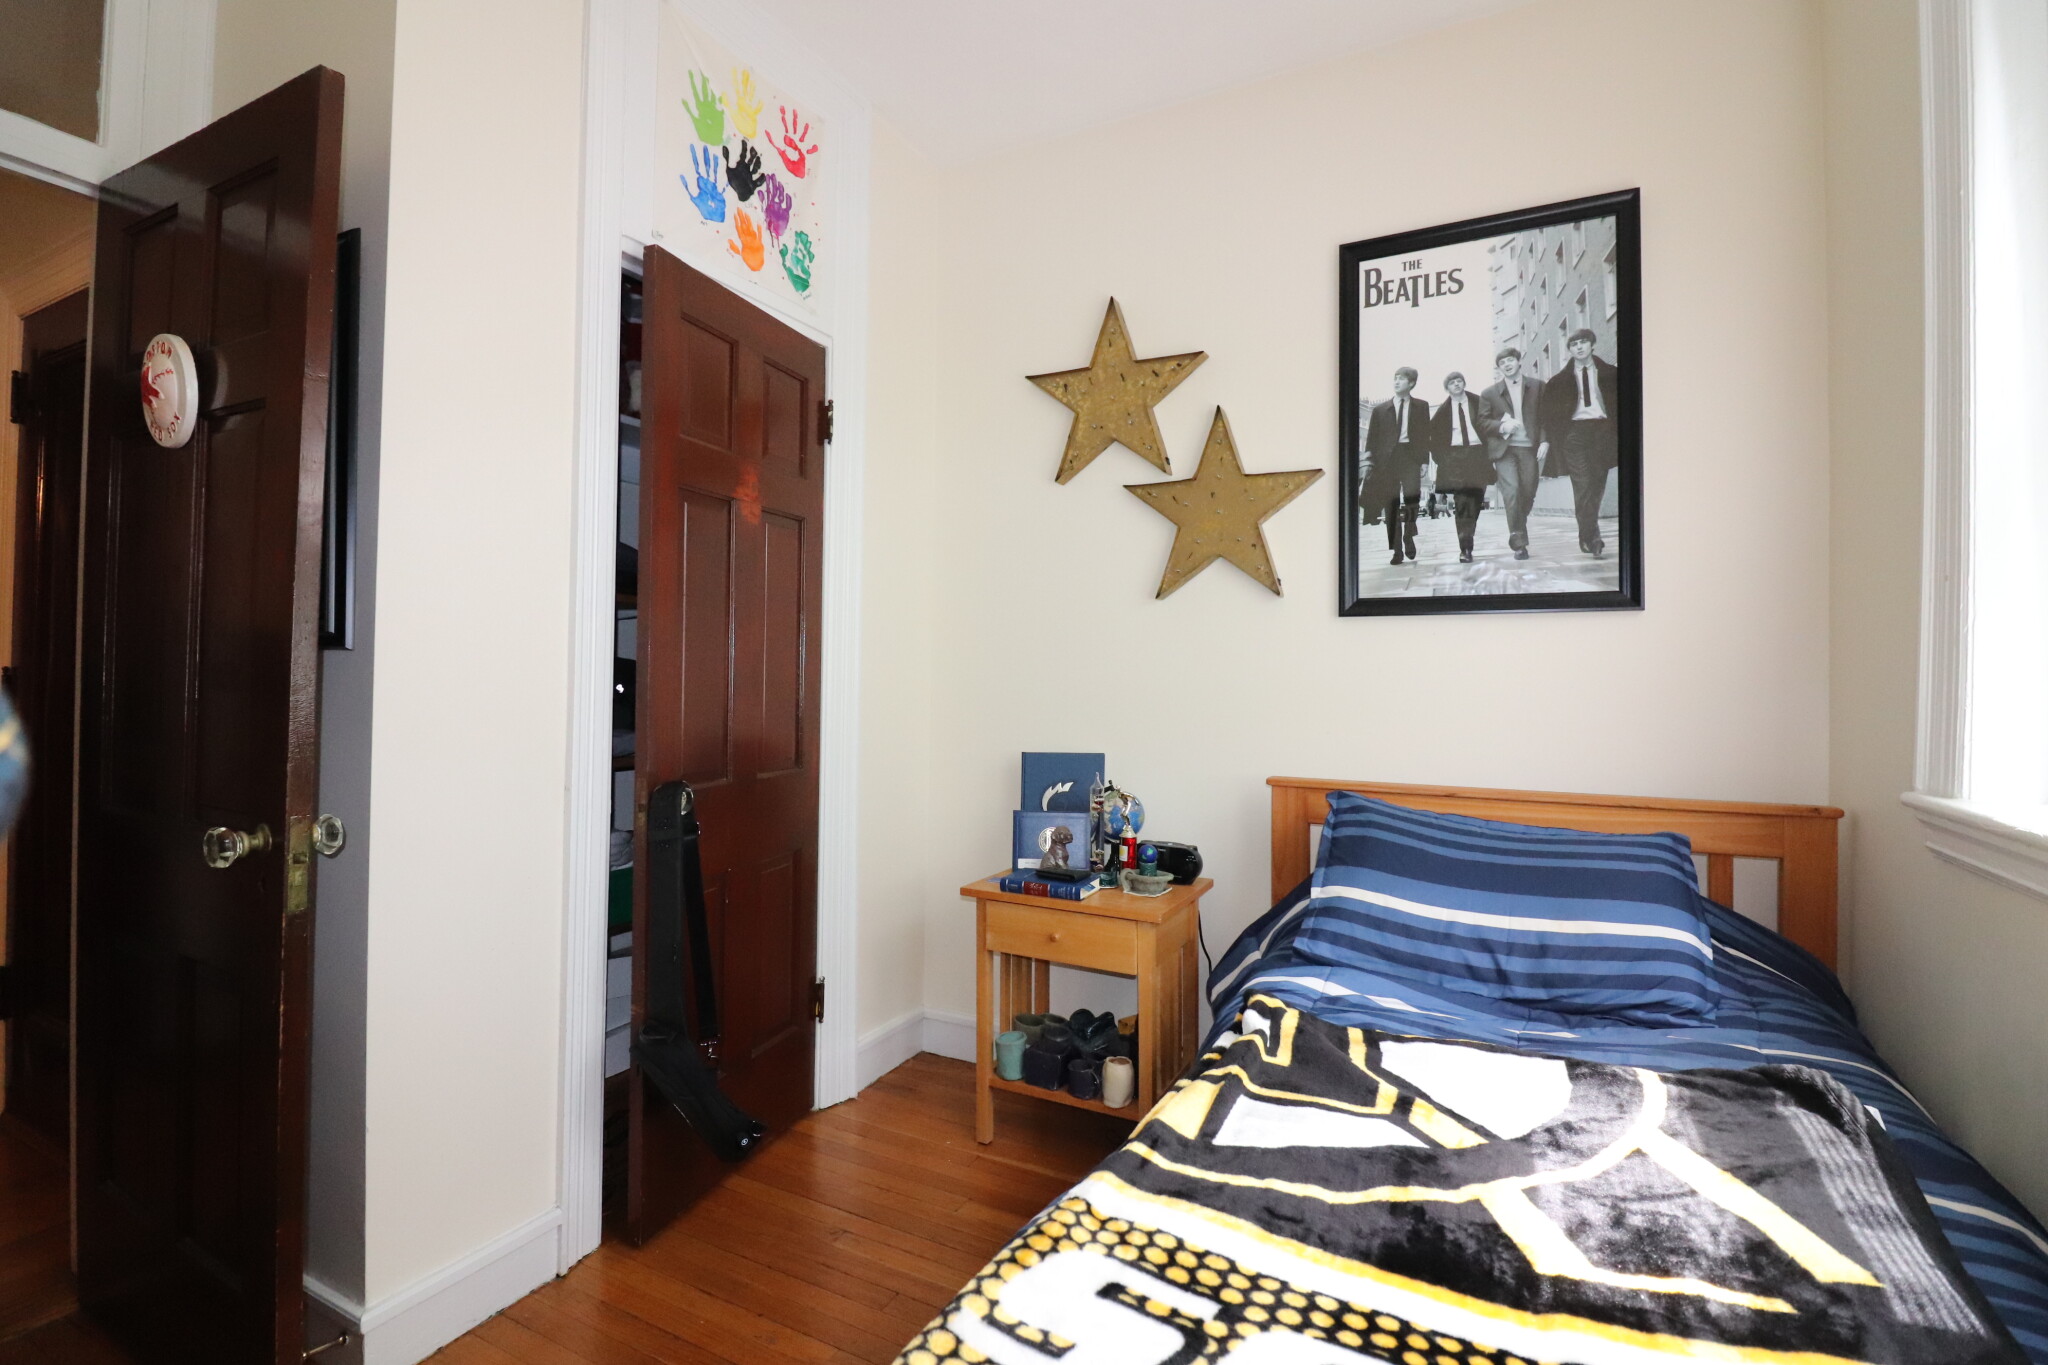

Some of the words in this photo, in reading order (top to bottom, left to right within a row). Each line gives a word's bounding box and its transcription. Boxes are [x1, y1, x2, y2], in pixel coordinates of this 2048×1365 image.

[1401, 258, 1423, 272] THE
[144, 341, 172, 363] OSTON
[167, 411, 181, 438] SOX
